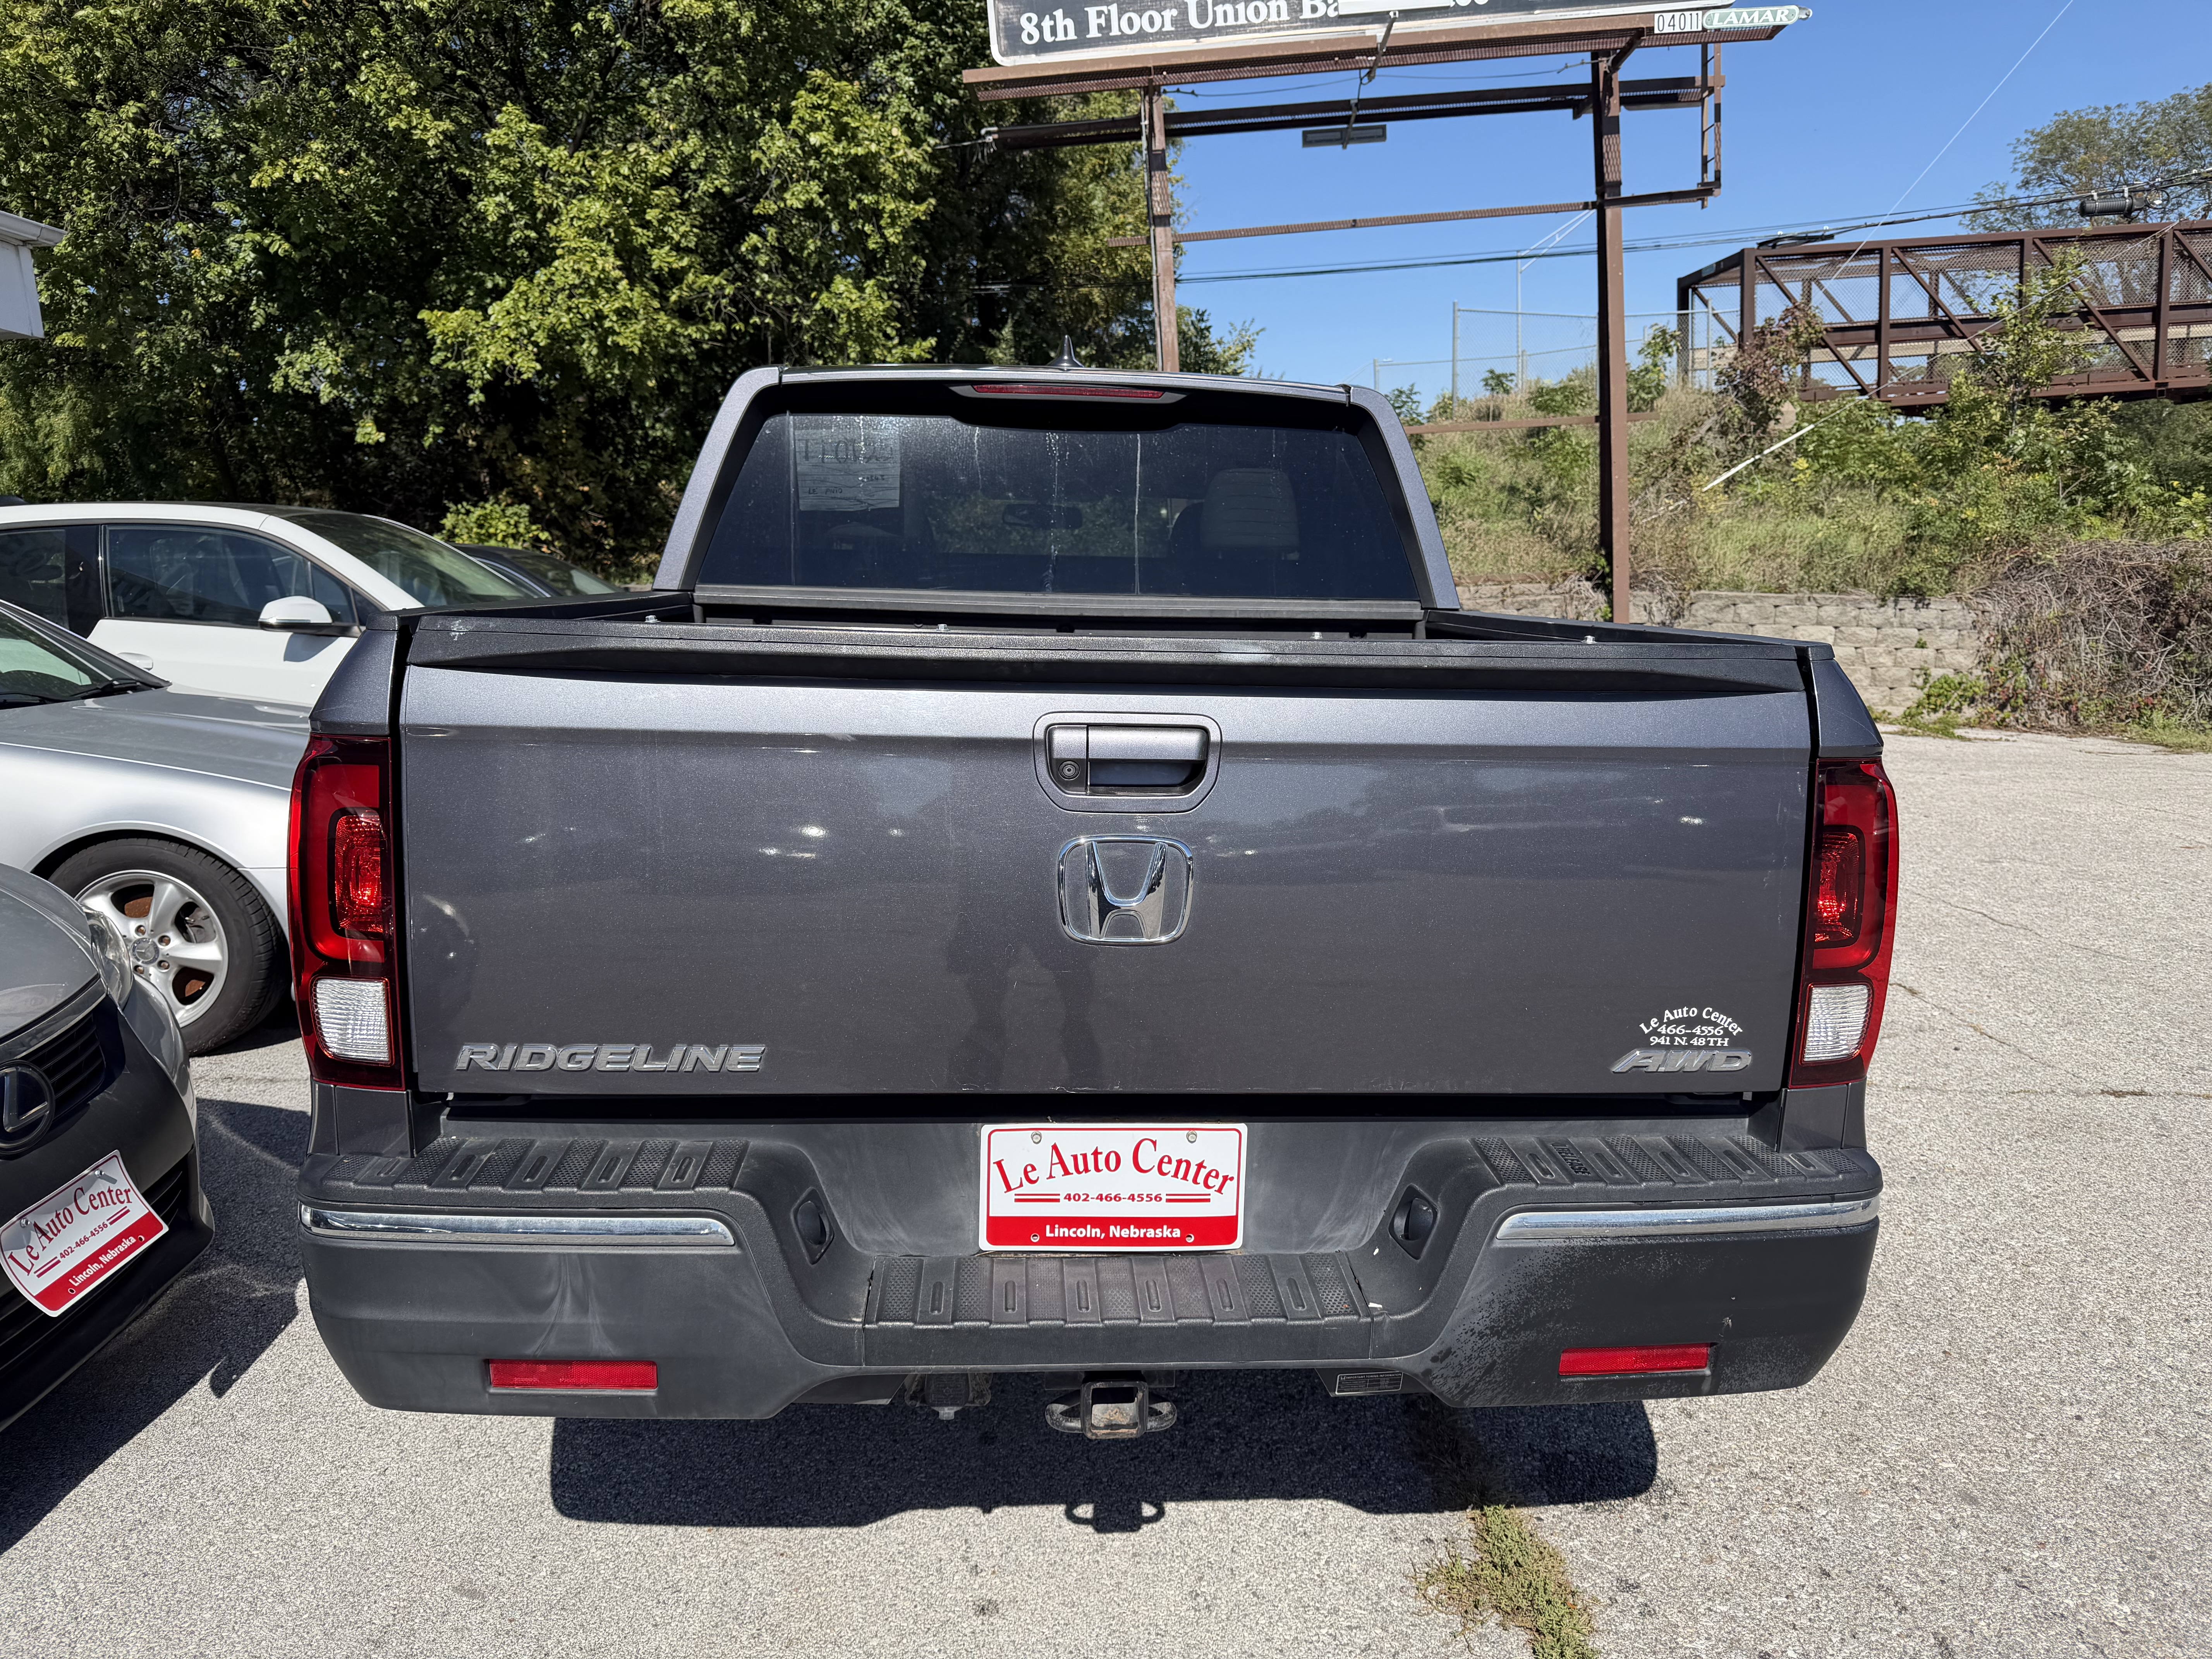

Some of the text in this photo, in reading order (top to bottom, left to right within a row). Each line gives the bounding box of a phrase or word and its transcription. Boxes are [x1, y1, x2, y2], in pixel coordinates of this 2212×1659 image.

[1020, 9, 1078, 45] 8th
[1084, 3, 1178, 38] Floor
[1187, 0, 1290, 29] Union
[1657, 12, 1699, 32] 04011
[1712, 9, 1789, 26] LAMAR
[1639, 1006, 1743, 1036] Le Auto Center
[1657, 1024, 1723, 1036] 466-4556
[1650, 1036, 1671, 1046] 941
[1674, 1037, 1688, 1046] N.
[455, 1042, 766, 1072] RIDGELINE
[1612, 1047, 1753, 1073] AWD
[993, 1138, 1235, 1195] Le Auto Center
[1063, 1193, 1163, 1202] 402-466-4556
[7, 1185, 132, 1276] Le Auto Center
[59, 1221, 108, 1259] 402-466-4556
[1045, 1224, 1181, 1239] Lincoln, Nebraska
[69, 1235, 136, 1287] Lincoln, Nebraska
